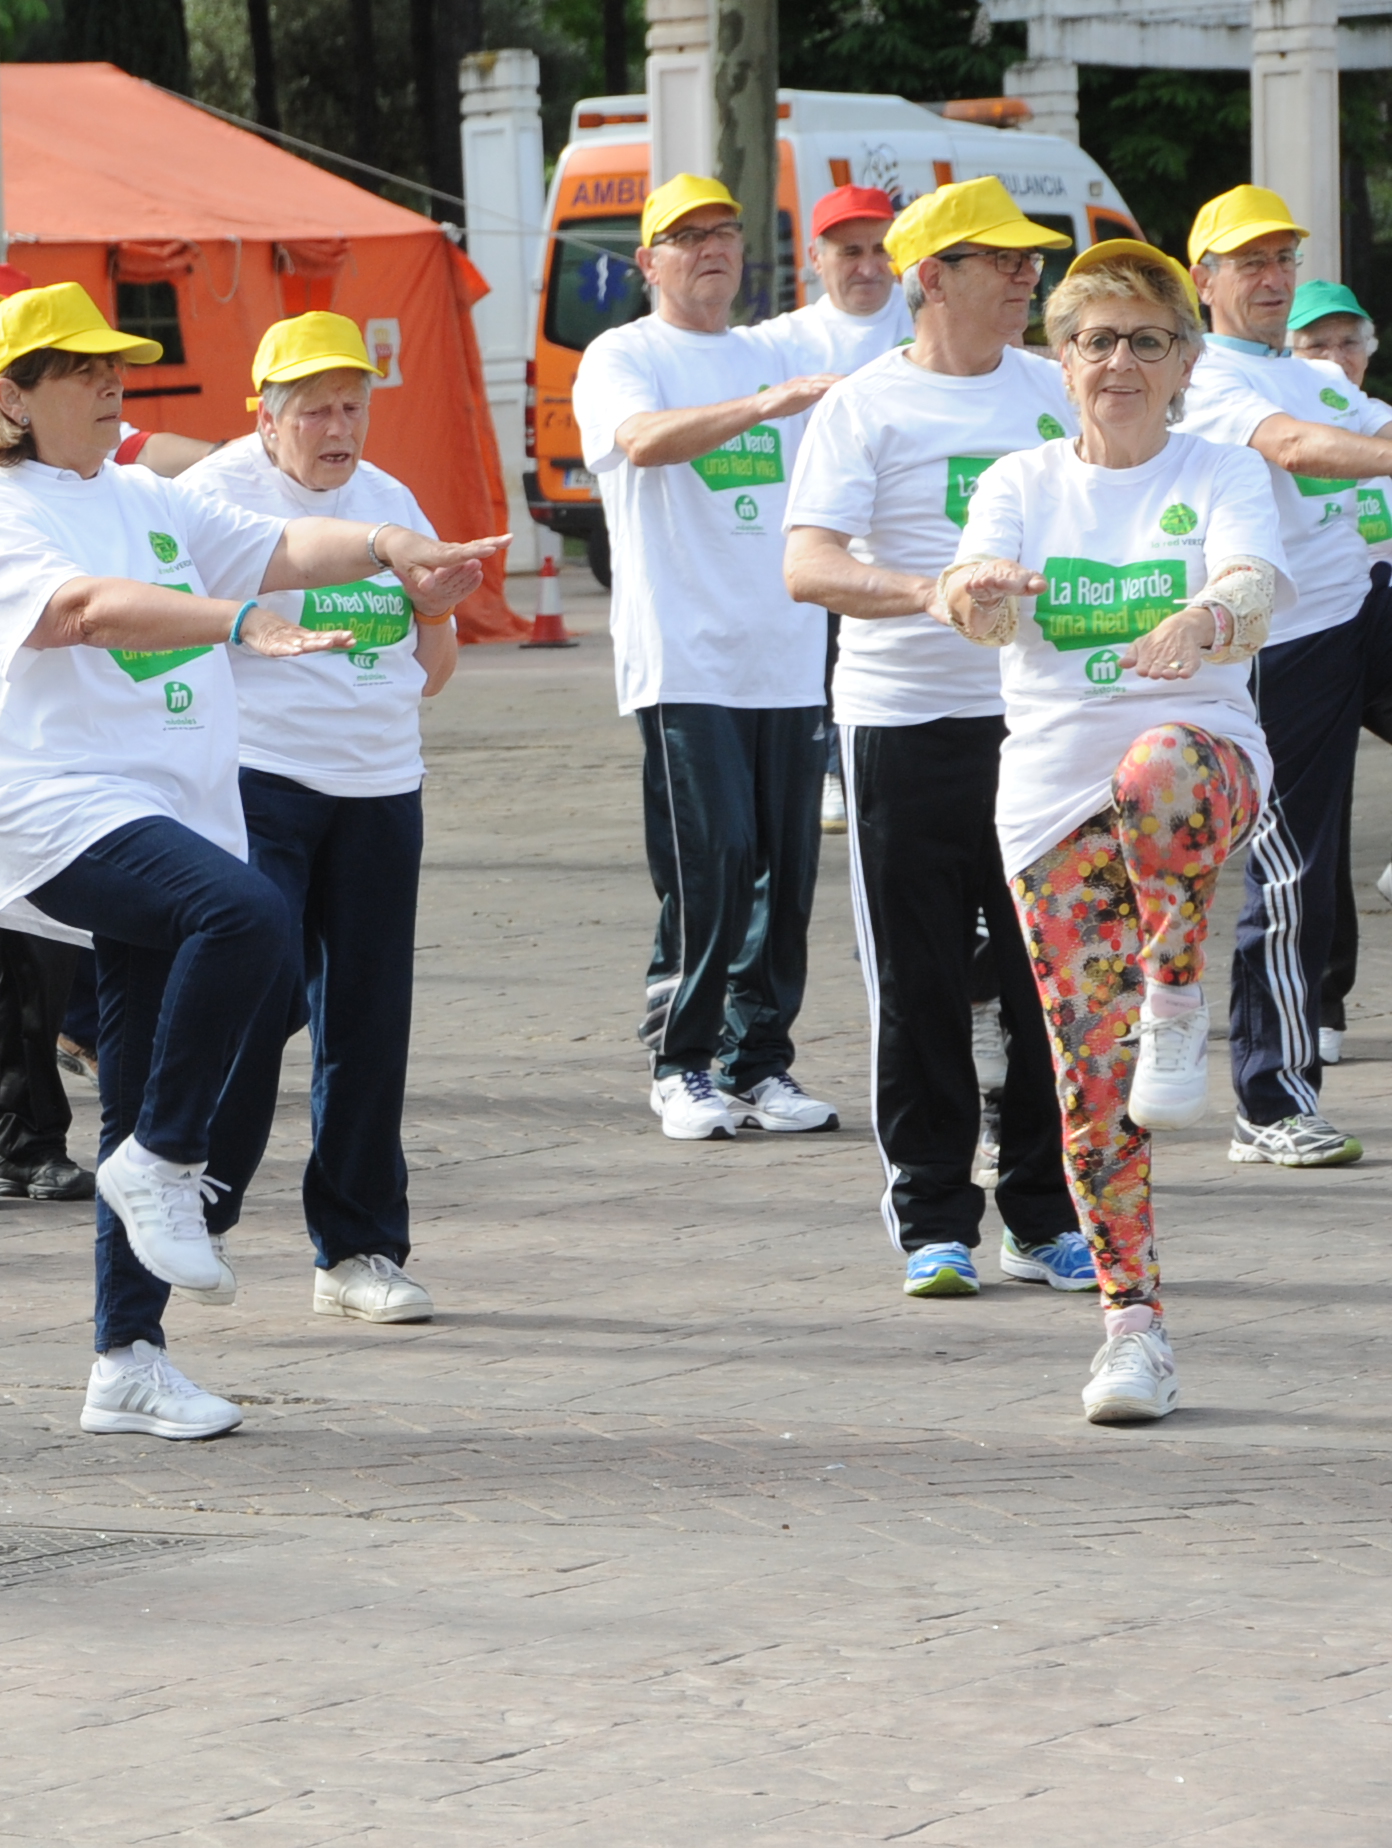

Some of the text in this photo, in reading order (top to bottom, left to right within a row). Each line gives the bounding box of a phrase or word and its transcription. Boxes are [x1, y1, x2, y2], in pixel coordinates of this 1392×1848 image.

[704, 457, 729, 475] una
[729, 453, 753, 476] Red
[311, 590, 405, 616] La Red Verde
[1050, 577, 1072, 606] La
[1077, 575, 1115, 606] Red
[348, 617, 376, 643] Red
[1049, 614, 1086, 636] una
[1091, 605, 1127, 633] Red
